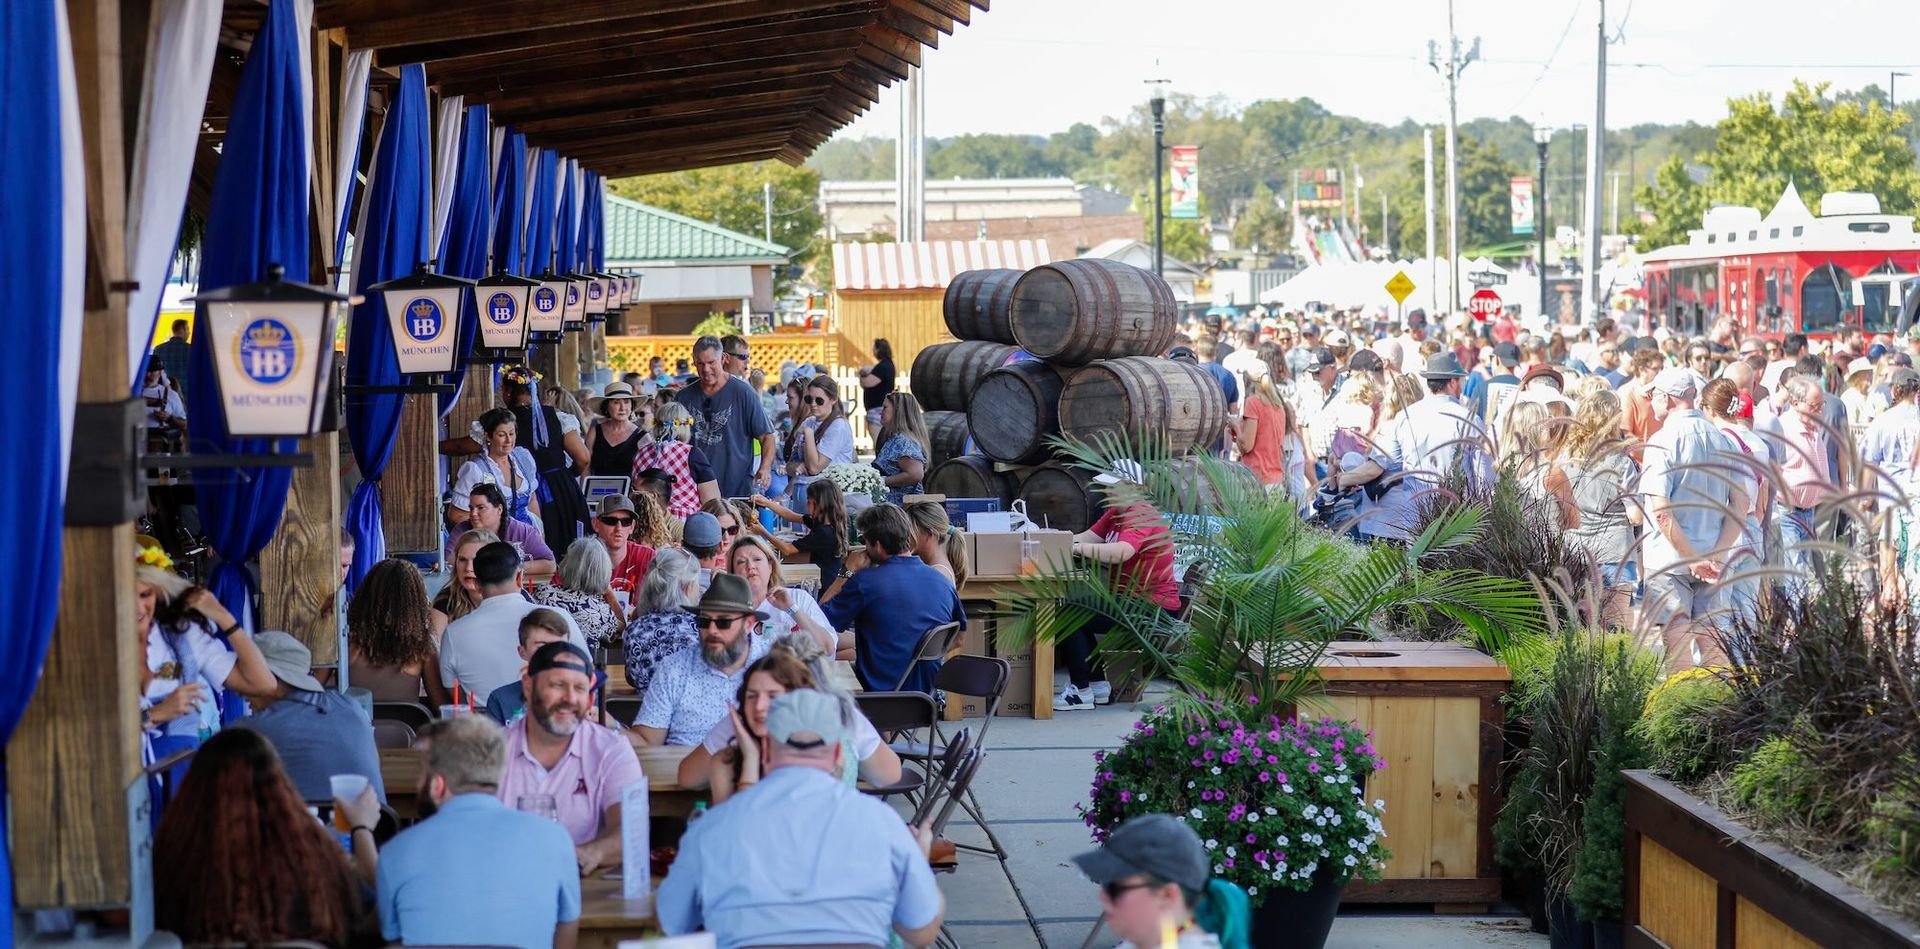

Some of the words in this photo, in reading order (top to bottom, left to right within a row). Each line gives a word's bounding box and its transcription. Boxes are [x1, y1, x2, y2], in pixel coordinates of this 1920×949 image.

[539, 299, 553, 310] HB
[1471, 298, 1501, 313] STOP
[494, 307, 511, 321] HB
[413, 318, 436, 337] HB
[485, 327, 520, 335] MÜNCHEN
[401, 345, 449, 356] MÜNCHEN
[251, 349, 288, 378] HB
[231, 392, 307, 407] MÜNCHEN
